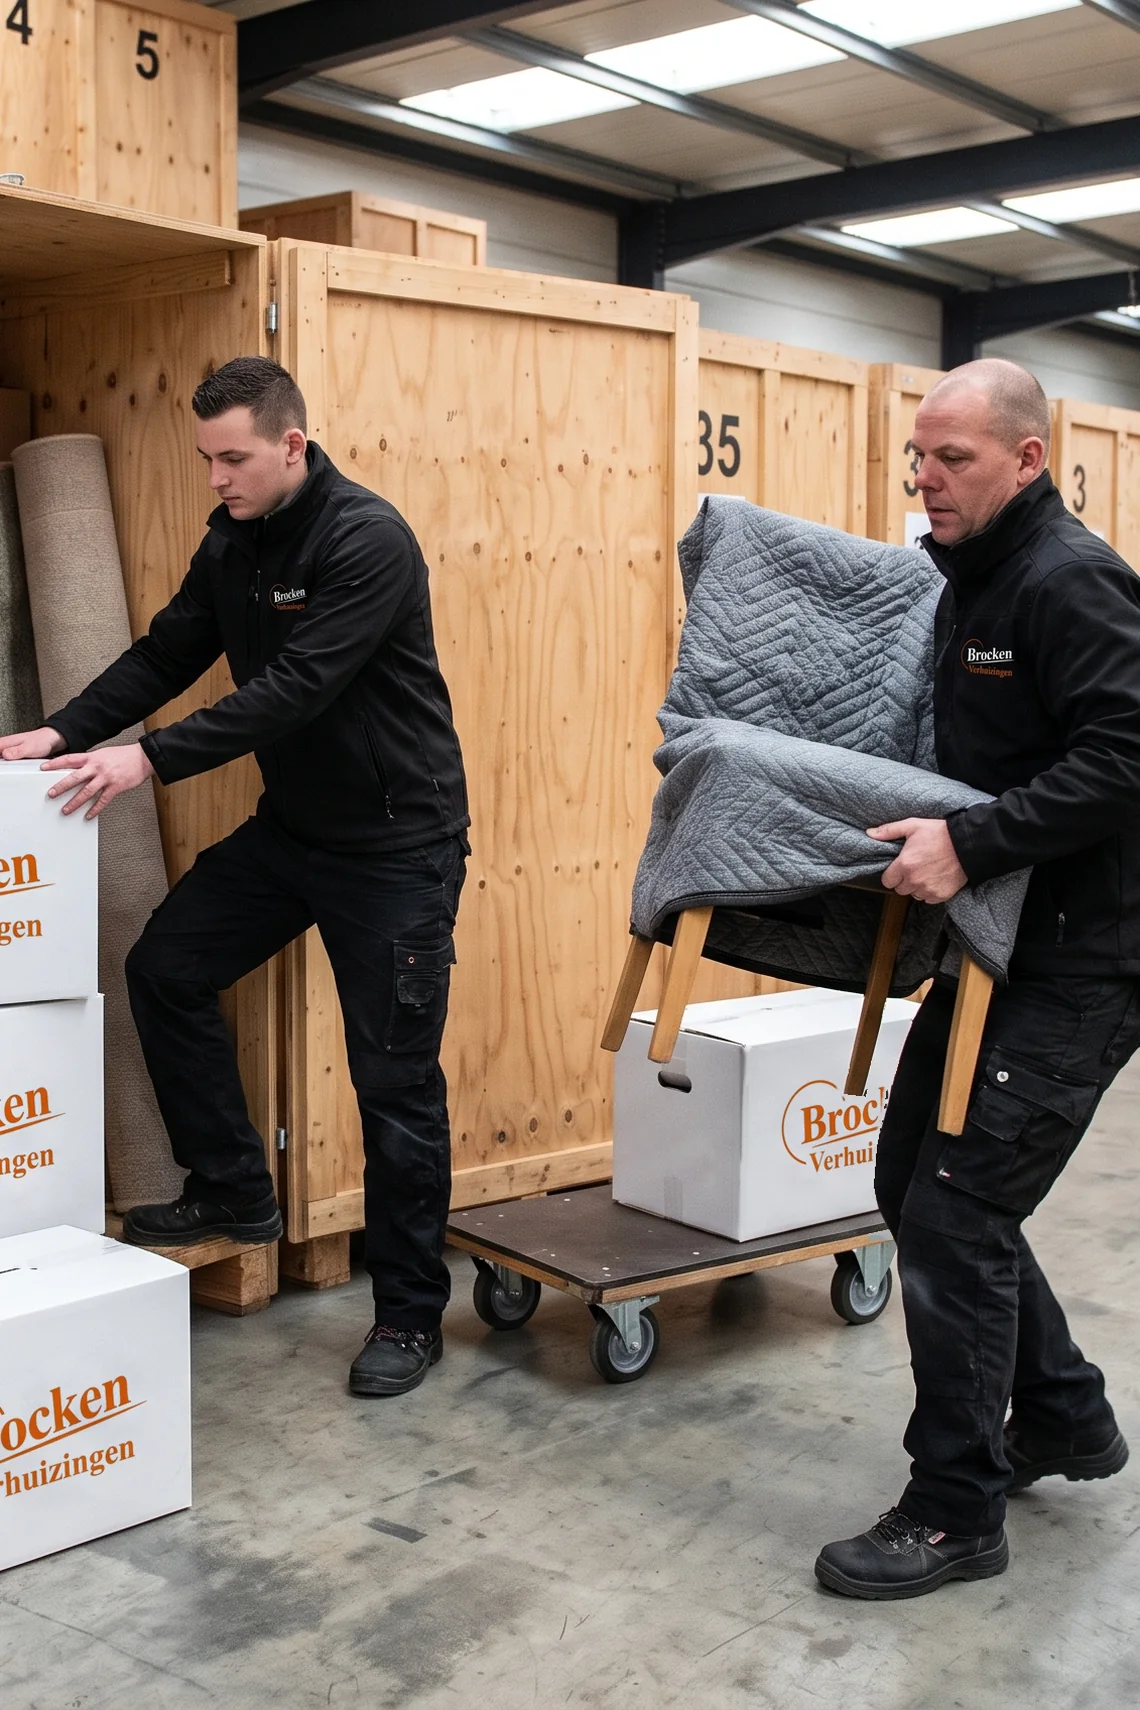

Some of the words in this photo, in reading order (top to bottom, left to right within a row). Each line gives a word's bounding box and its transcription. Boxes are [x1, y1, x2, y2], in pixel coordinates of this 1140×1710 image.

[6, 0, 33, 46] 4
[135, 28, 160, 81] 5
[1072, 463, 1086, 513] 3
[273, 588, 306, 603] Brocken
[966, 647, 1013, 662] Brocken
[0, 1086, 52, 1128] en
[809, 1141, 874, 1173] Verhui
[0, 1375, 132, 1451] ocken
[0, 1440, 136, 1497] huizingen
